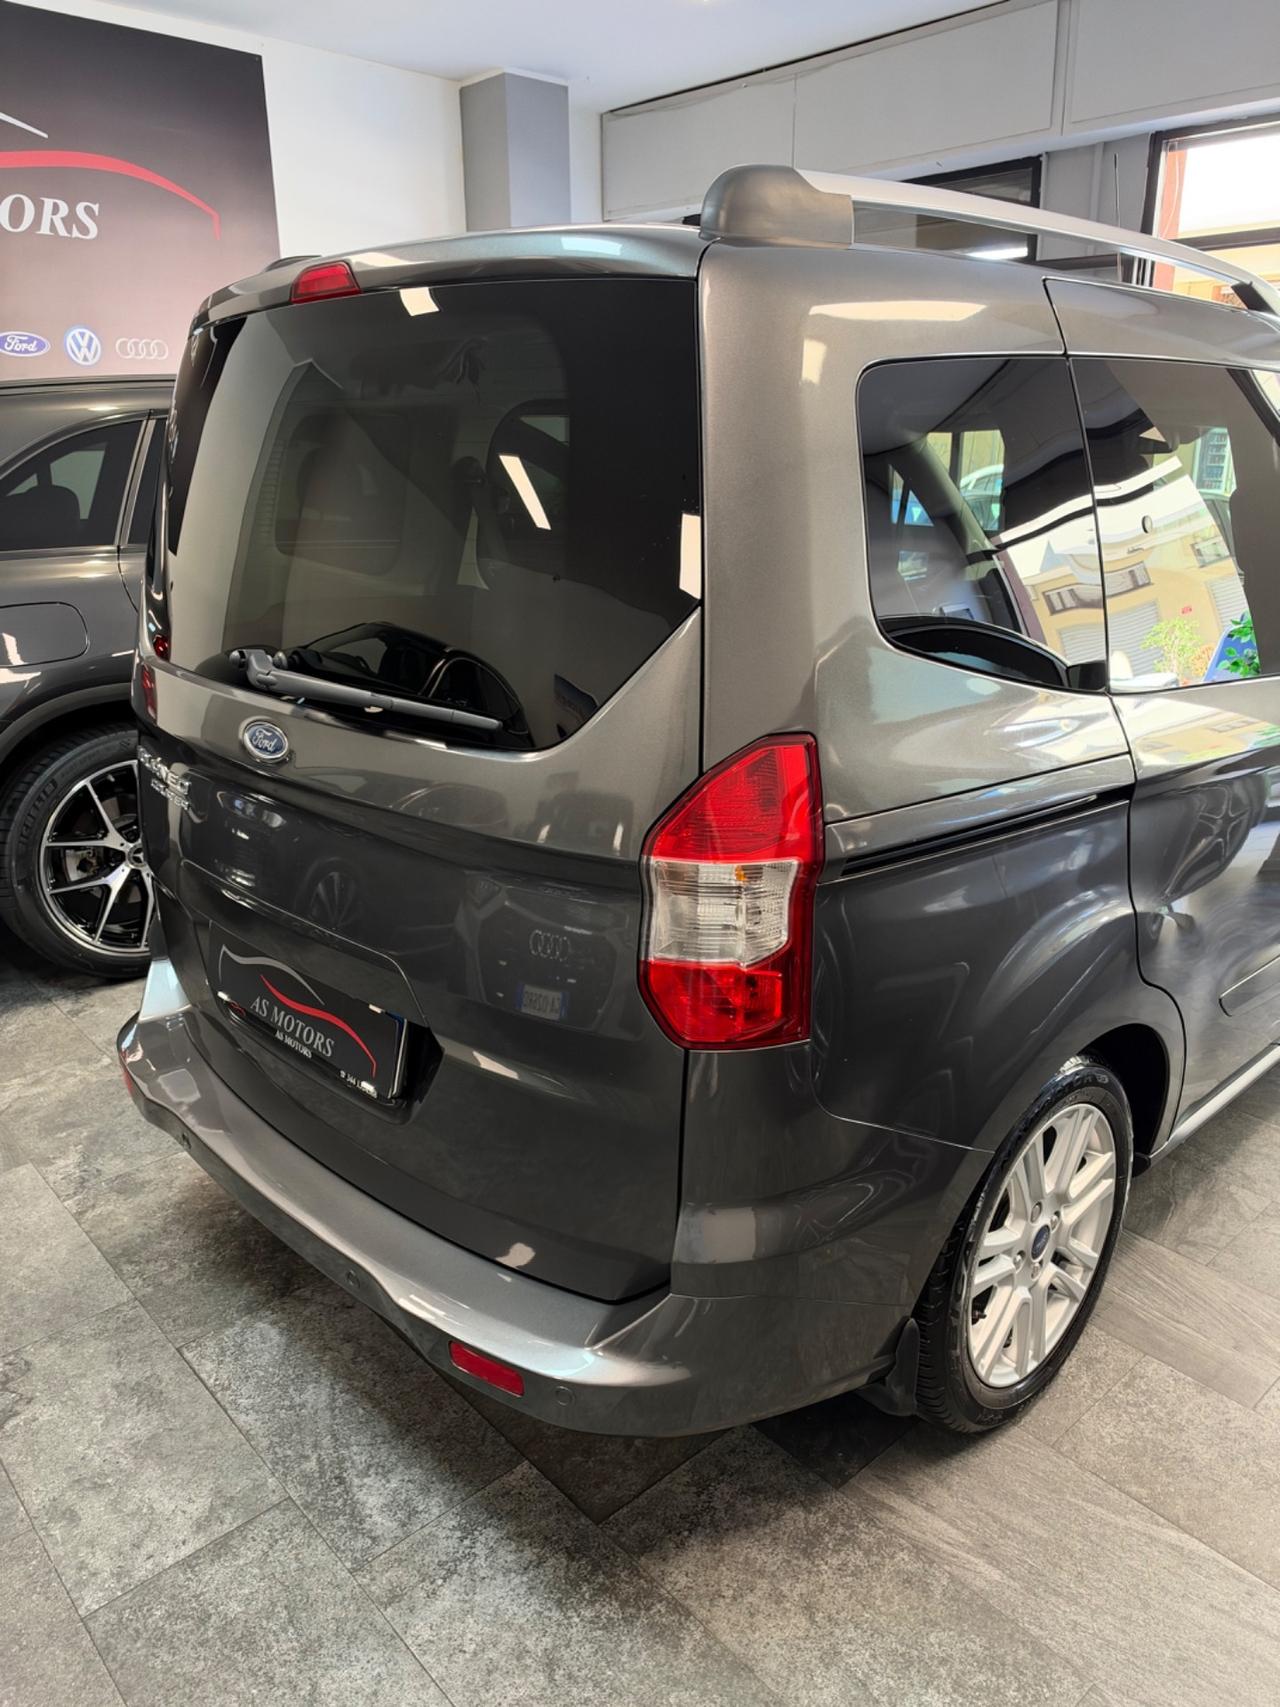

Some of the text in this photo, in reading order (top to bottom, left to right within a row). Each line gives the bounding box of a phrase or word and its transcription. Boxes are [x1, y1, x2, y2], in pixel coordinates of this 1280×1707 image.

[4, 334, 38, 352] Ford
[252, 727, 278, 752] Ford
[250, 996, 335, 1057] AS MOTORS
[275, 1030, 312, 1058] AS MOTORS
